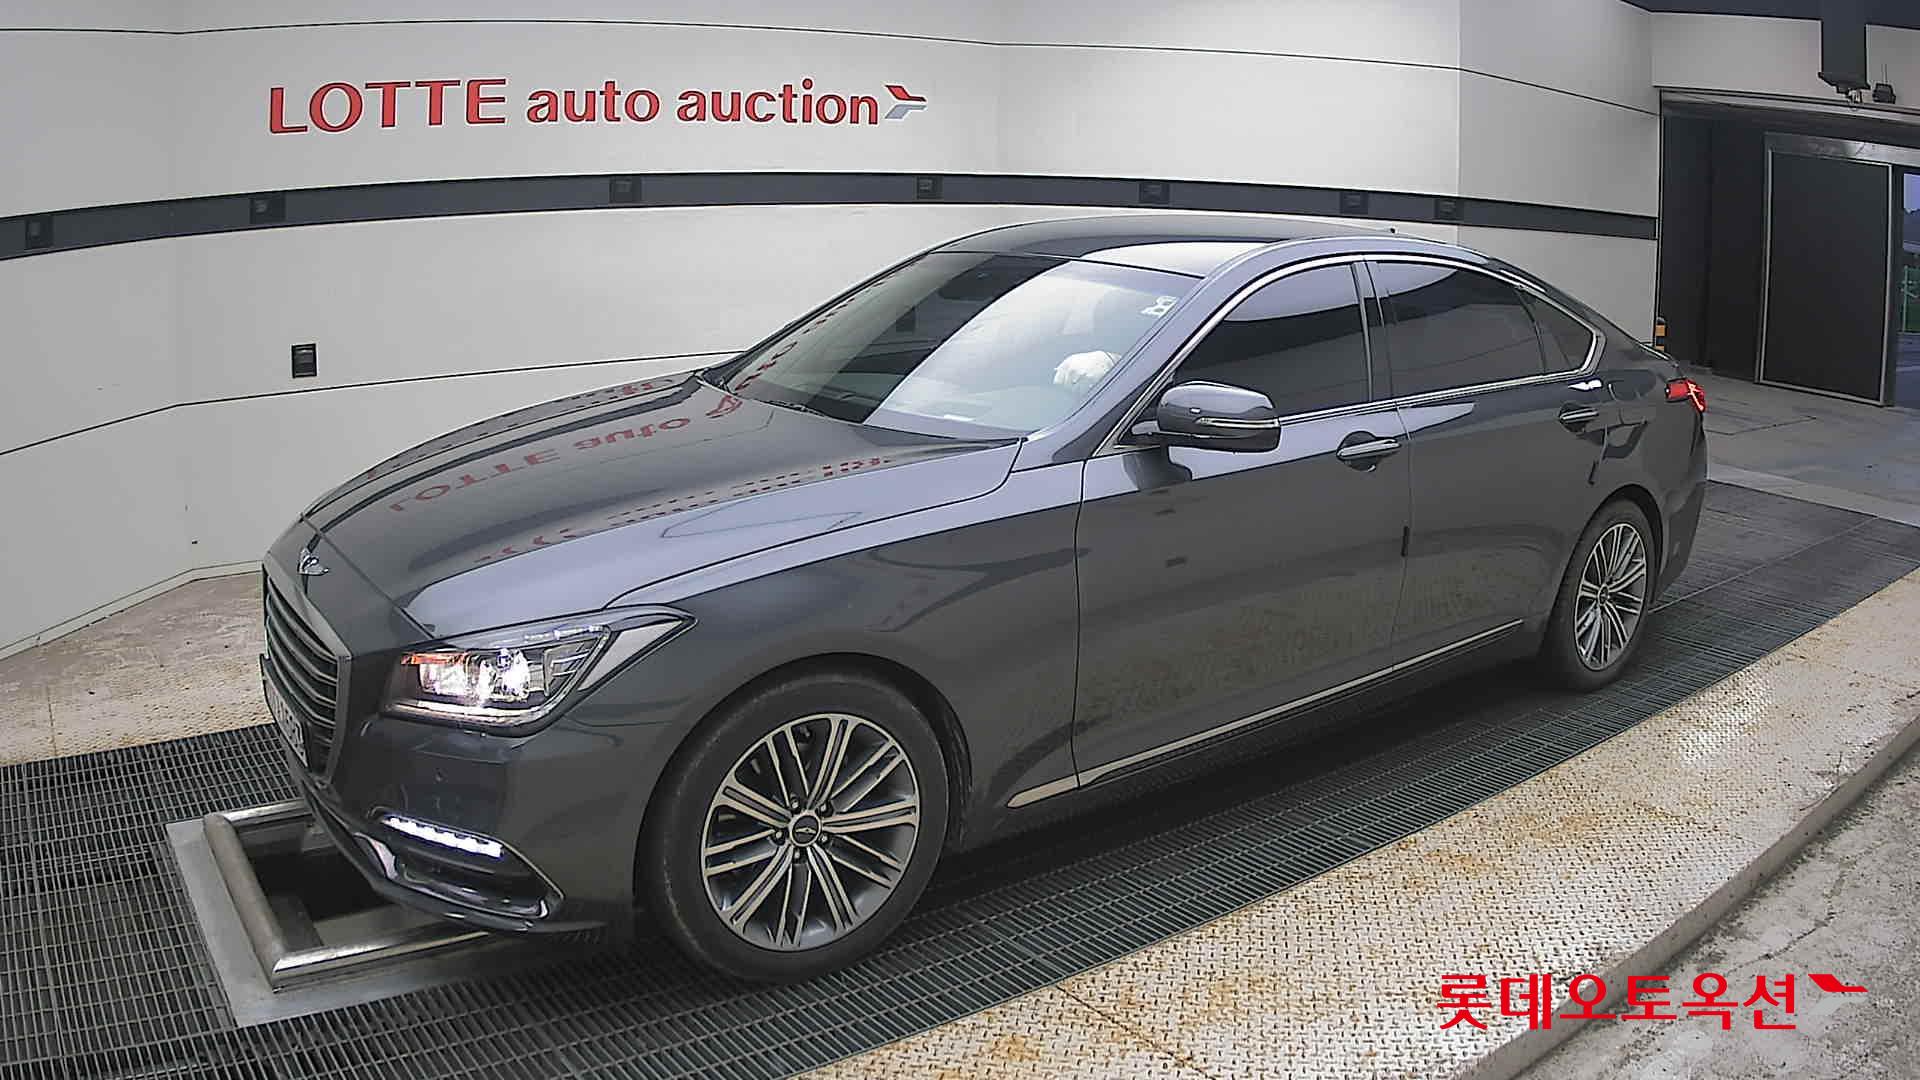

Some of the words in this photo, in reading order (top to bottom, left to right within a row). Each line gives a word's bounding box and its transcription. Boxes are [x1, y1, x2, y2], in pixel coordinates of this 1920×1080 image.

[268, 78, 507, 134] LOTTE
[526, 80, 661, 123] auto
[676, 78, 879, 126] auction
